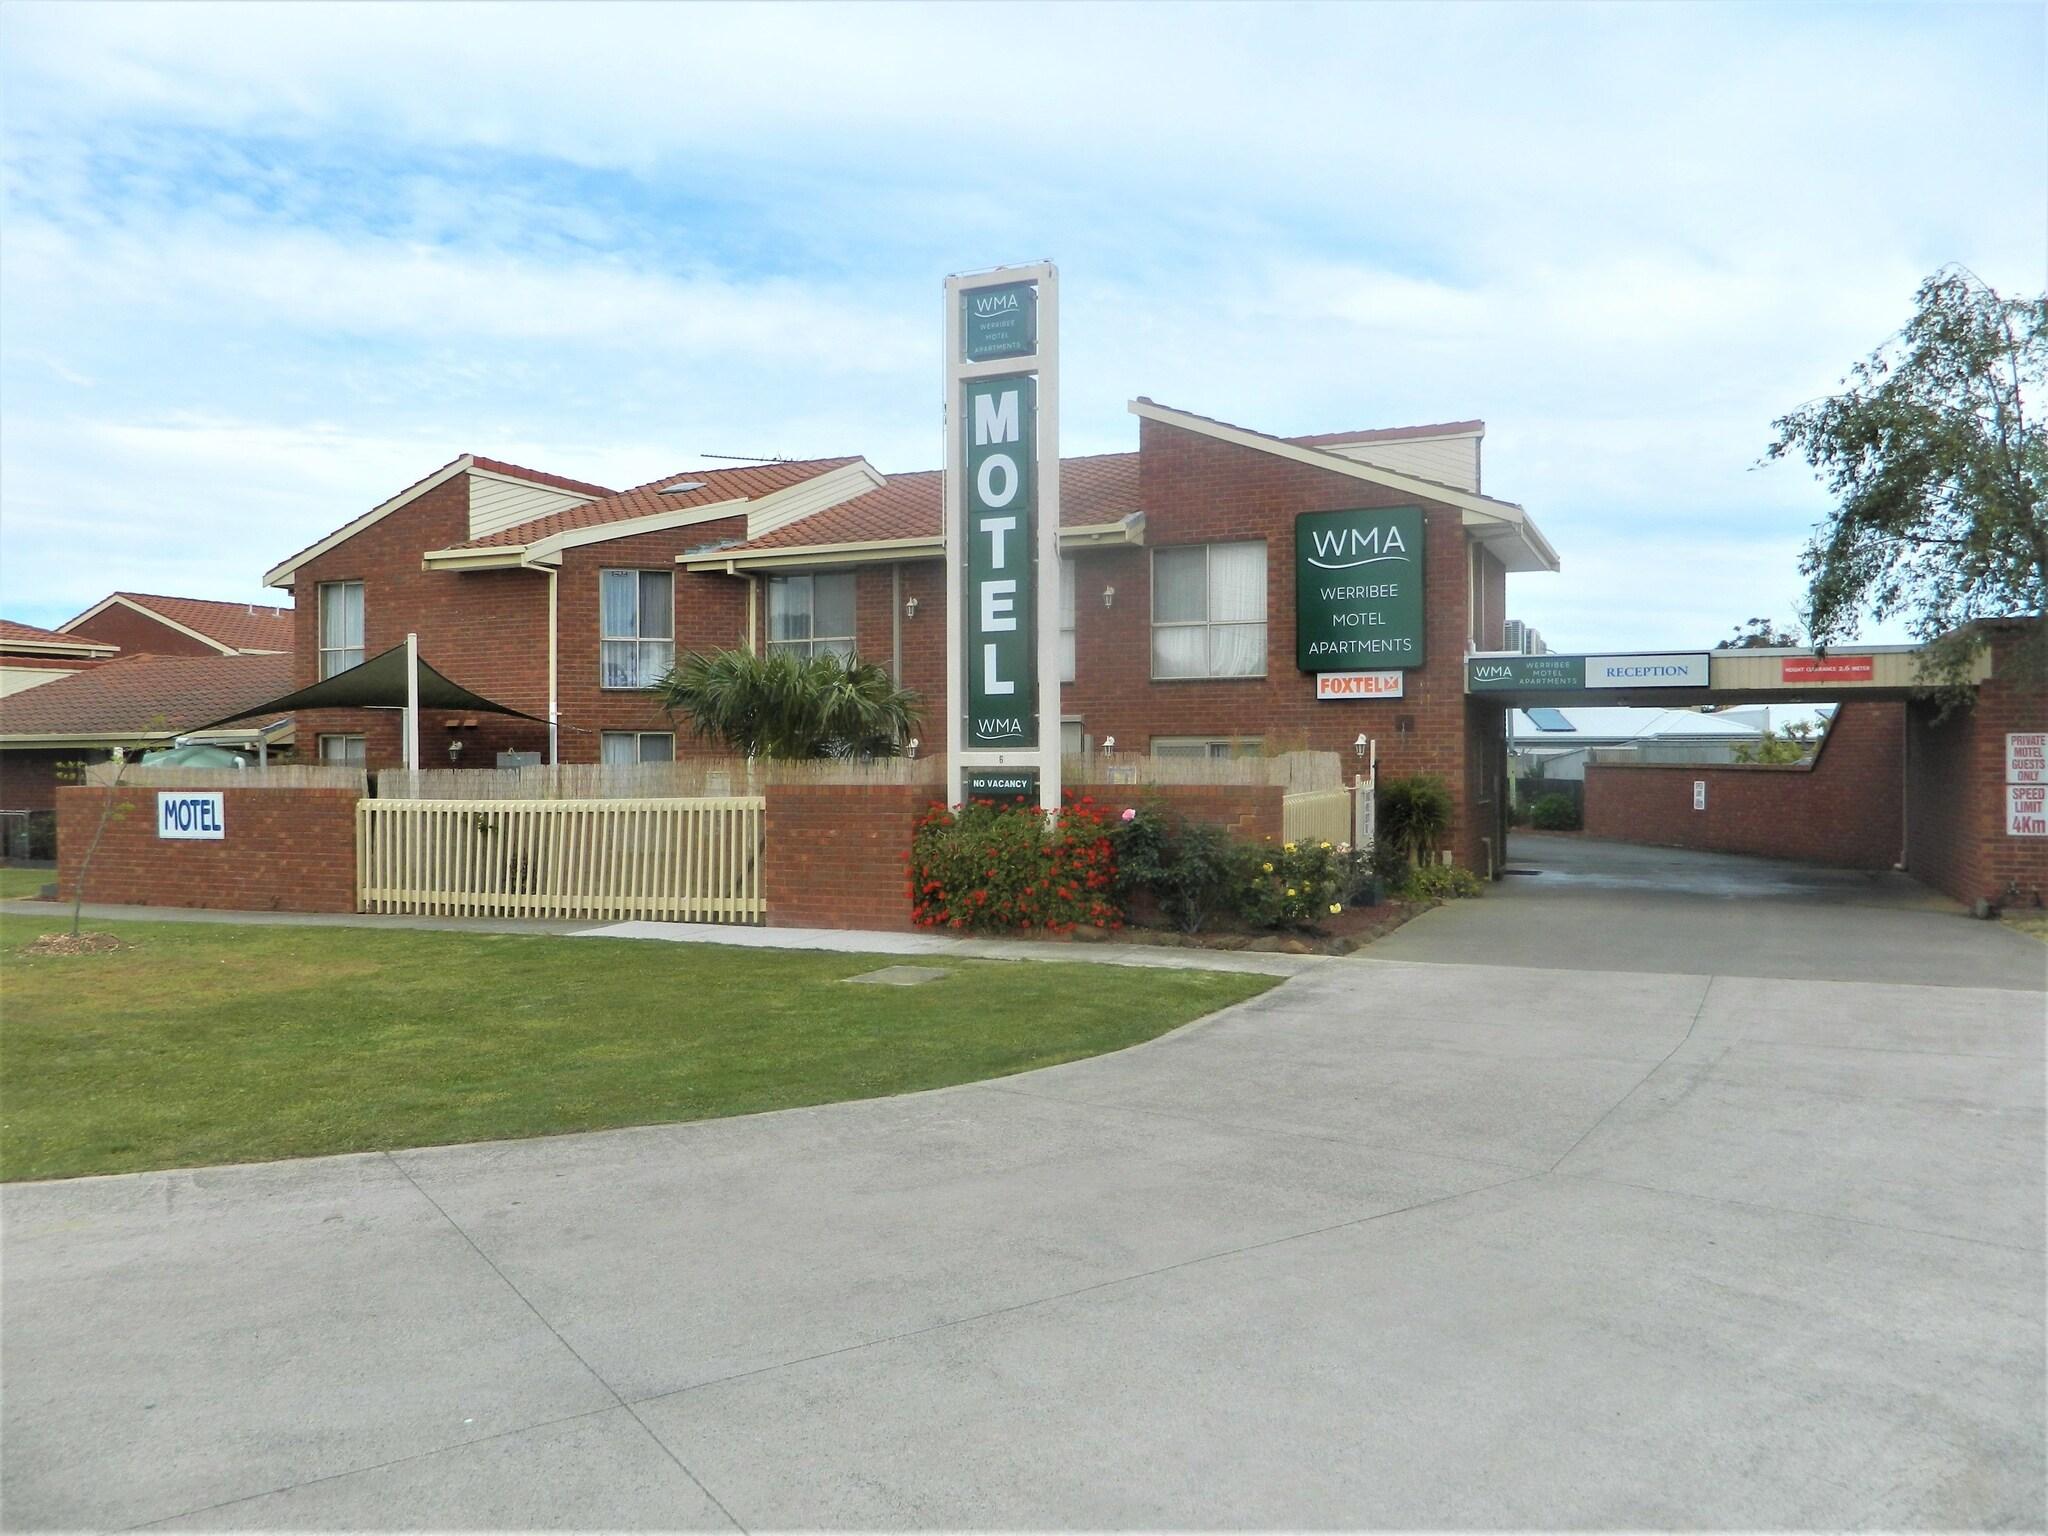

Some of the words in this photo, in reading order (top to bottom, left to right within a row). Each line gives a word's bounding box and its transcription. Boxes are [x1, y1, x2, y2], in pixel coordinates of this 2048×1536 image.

[977, 294, 1018, 312] WMA
[985, 332, 1008, 340] MOTEL
[975, 341, 1021, 353] APARTMENTS
[975, 390, 1019, 695] MOTEL
[1312, 526, 1405, 557] WMA
[1320, 584, 1398, 600] WERRIBEE
[1333, 612, 1386, 627] MOTEL
[1309, 638, 1412, 654] APARTMENTS
[1475, 666, 1512, 677] WMA
[1606, 665, 1689, 678] RECEPTION
[1320, 678, 1382, 694] FOXTEL
[978, 718, 1022, 733] WMA
[2011, 735, 2046, 746] PRIVATE
[2014, 747, 2042, 757] MOTEL
[2012, 759, 2045, 769] GUESTS
[2017, 770, 2039, 780] ONLY
[973, 780, 985, 788] NO
[987, 780, 1027, 788] VACANCY
[2012, 788, 2045, 800] SPEED
[2015, 801, 2042, 813] LIMIT
[165, 799, 221, 831] MOTEL
[2012, 816, 2046, 833] 4Km
